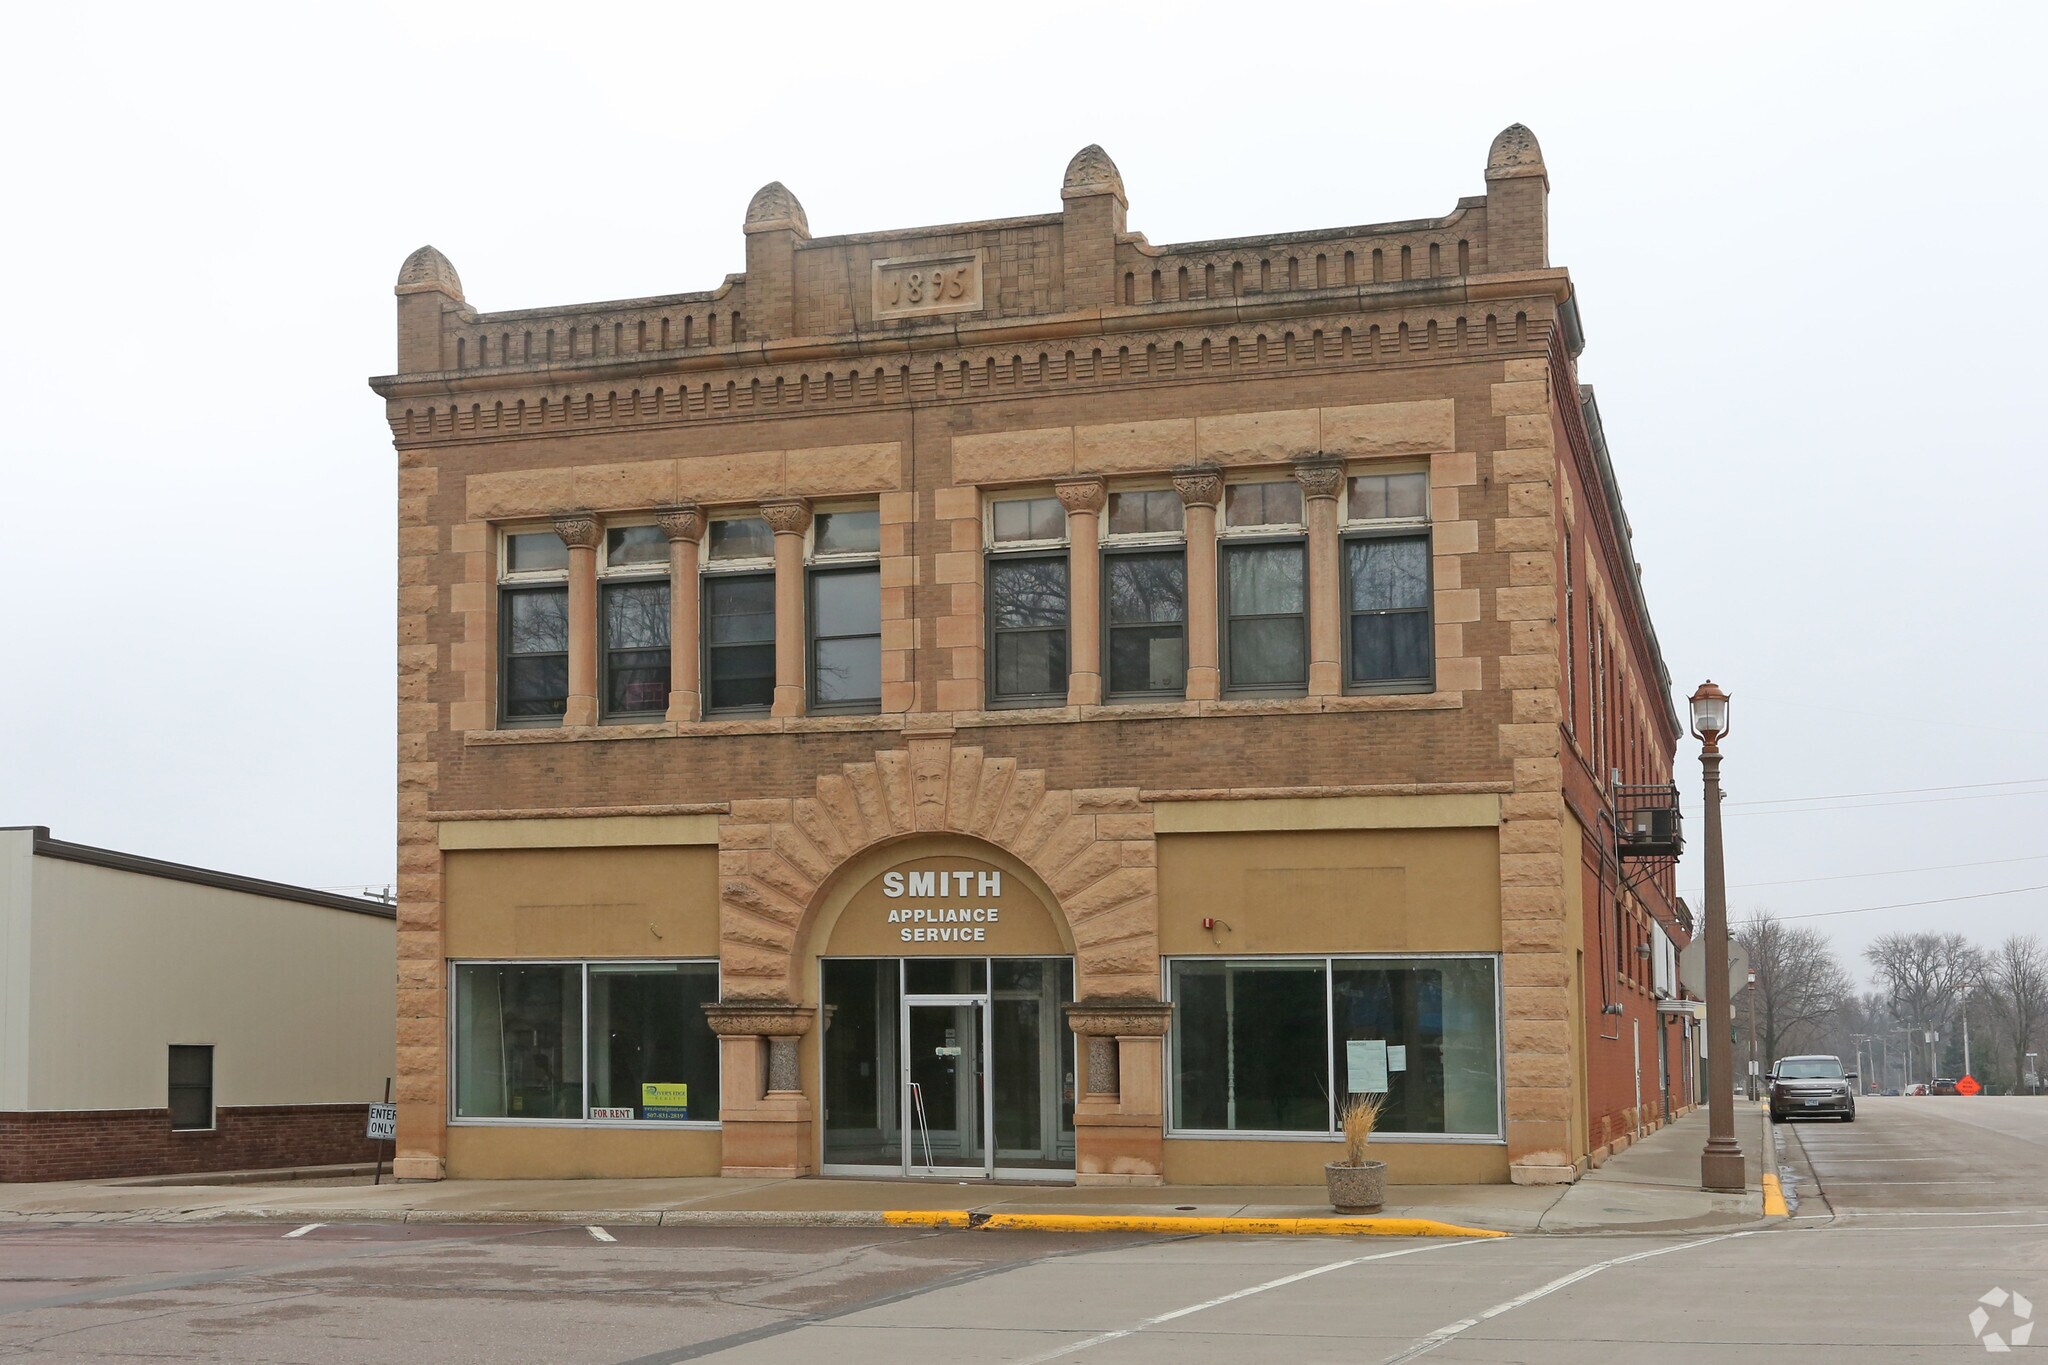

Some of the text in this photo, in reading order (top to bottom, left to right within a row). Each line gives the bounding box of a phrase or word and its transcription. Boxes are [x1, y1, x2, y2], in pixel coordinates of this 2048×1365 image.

[891, 266, 967, 306] 1895
[883, 871, 1001, 898] SMITH
[887, 908, 999, 923] APPLIANCE
[900, 928, 985, 942] SERVICE
[593, 1109, 630, 1118] FOR RENT
[371, 1122, 395, 1134] ONLY
